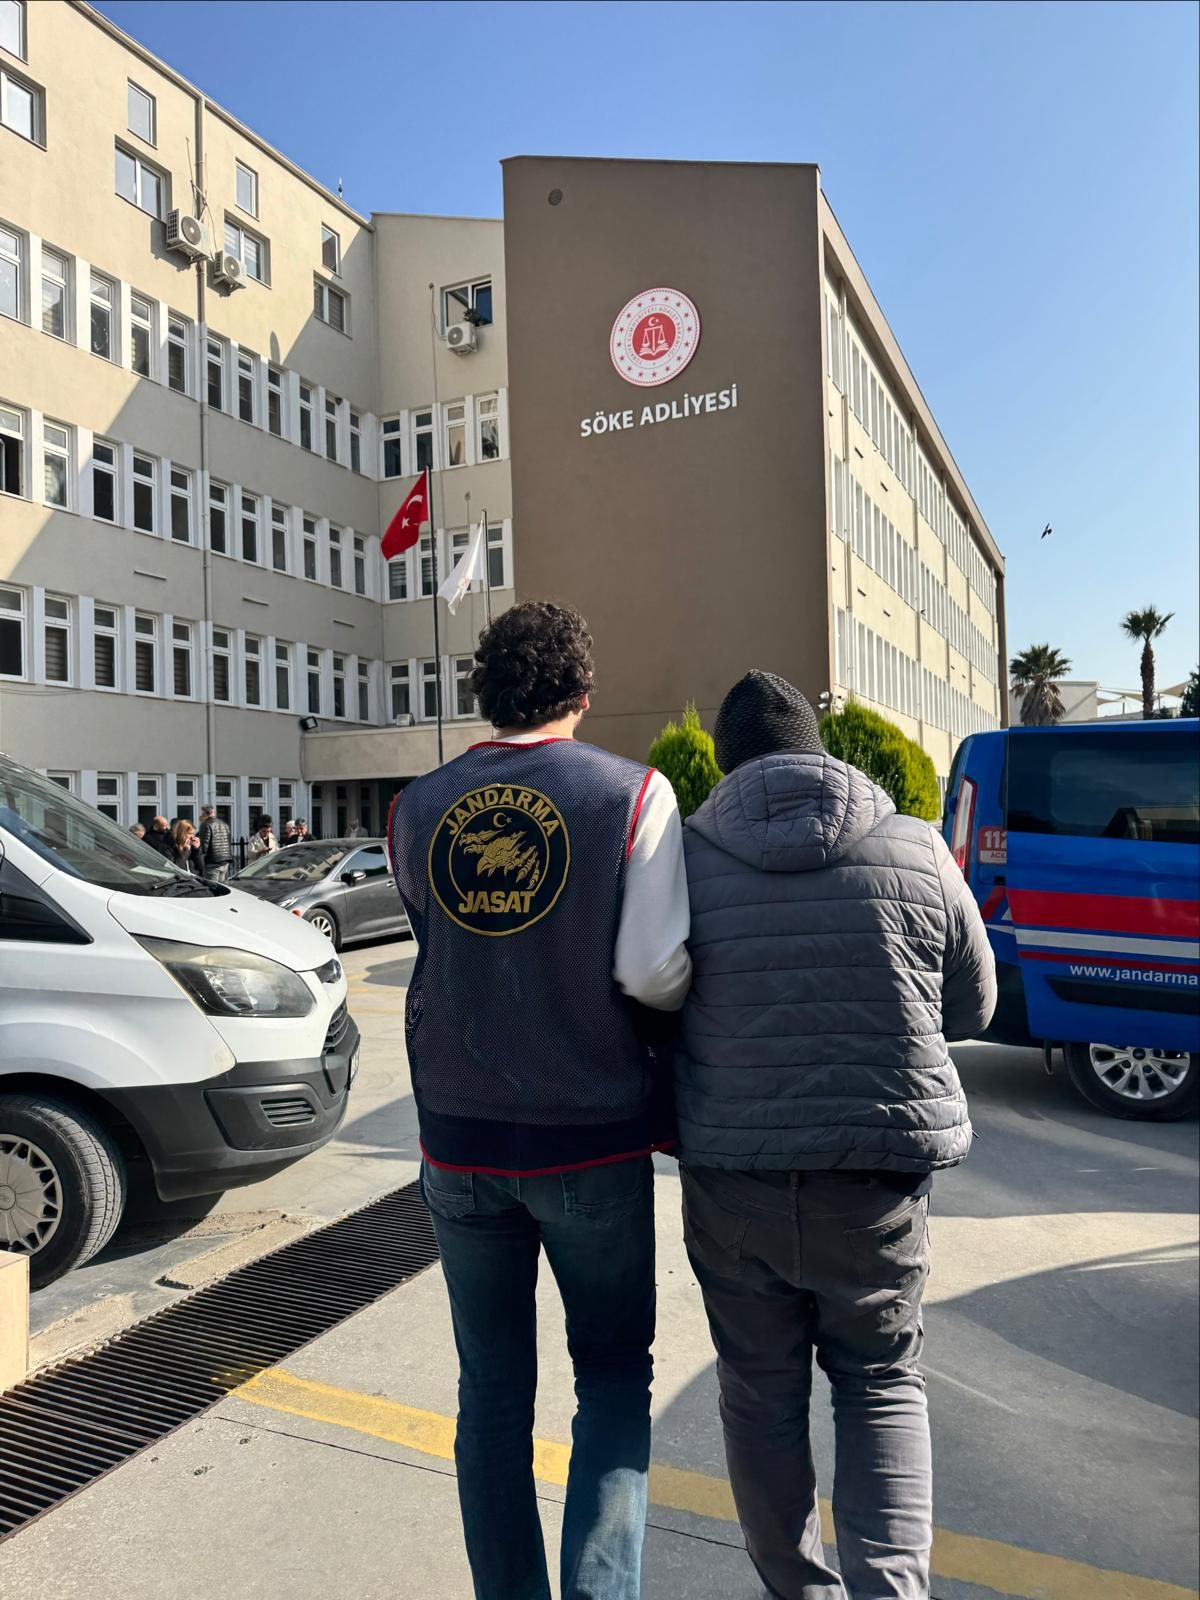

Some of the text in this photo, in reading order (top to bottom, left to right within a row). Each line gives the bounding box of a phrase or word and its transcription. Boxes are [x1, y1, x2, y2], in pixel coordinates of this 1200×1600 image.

[580, 384, 738, 437] SÖKE ADLİYESİ
[445, 788, 560, 837] JANDARMA
[458, 890, 536, 914] JASAT
